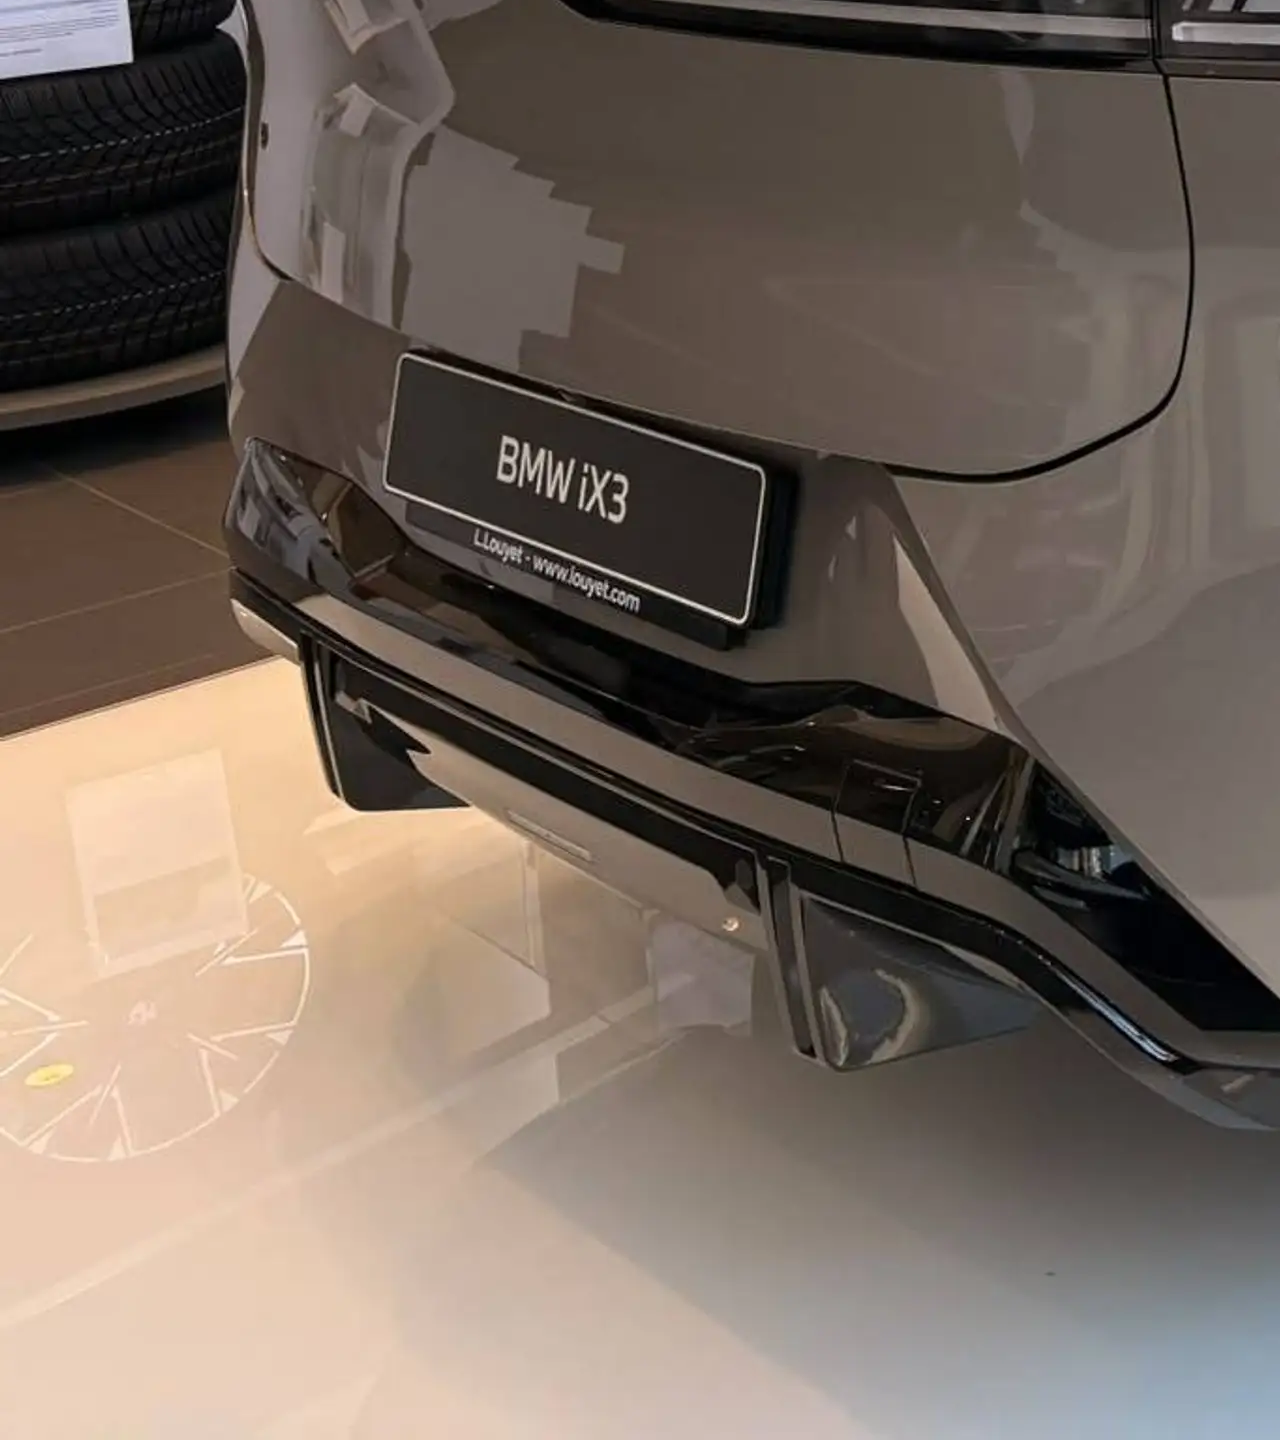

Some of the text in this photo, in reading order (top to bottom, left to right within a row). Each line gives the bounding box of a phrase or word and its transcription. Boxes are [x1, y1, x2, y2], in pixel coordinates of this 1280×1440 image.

[496, 435, 630, 524] BMW iX3
[473, 528, 524, 563] L.Louyet
[532, 554, 641, 612] www.louyet.com
